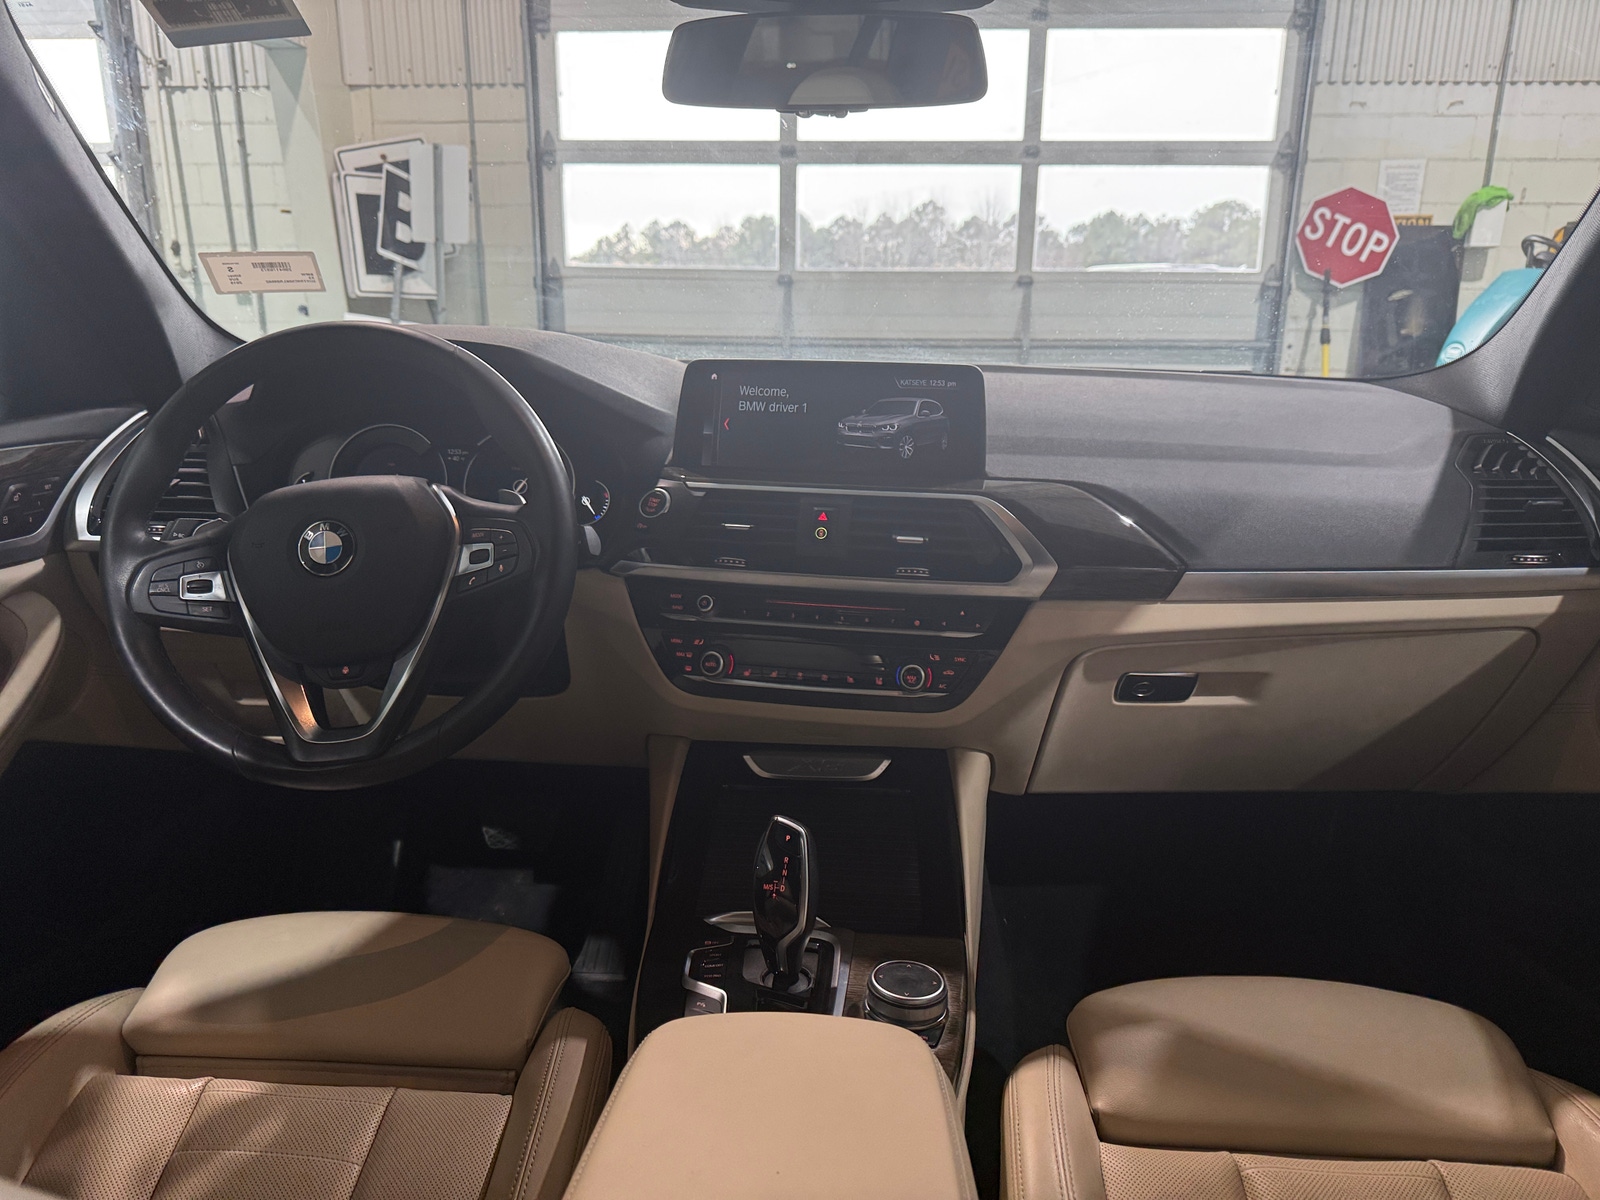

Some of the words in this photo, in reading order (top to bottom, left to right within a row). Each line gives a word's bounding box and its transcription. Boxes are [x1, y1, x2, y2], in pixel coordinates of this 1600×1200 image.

[1304, 206, 1390, 263] STOP
[929, 379, 946, 387] 12:53
[739, 385, 790, 399] Welcome,
[738, 400, 766, 412] BMW
[768, 402, 798, 413] driver
[802, 403, 808, 413] 1
[304, 522, 349, 541] BMW
[780, 884, 786, 892] D
